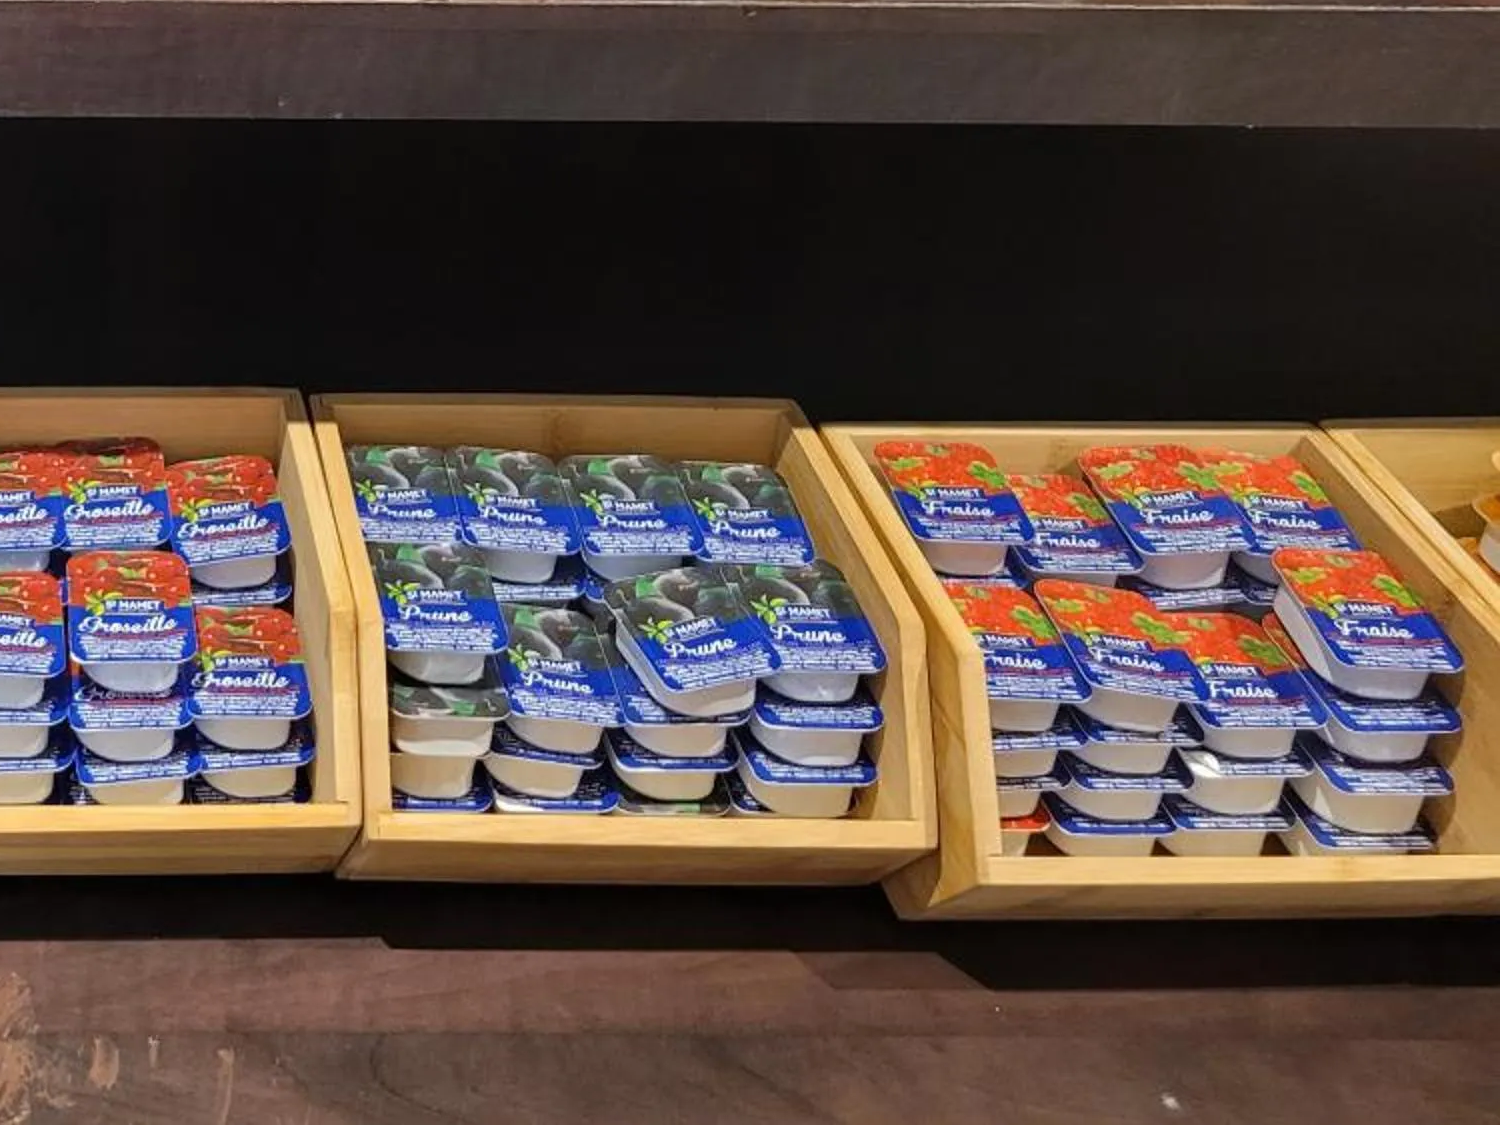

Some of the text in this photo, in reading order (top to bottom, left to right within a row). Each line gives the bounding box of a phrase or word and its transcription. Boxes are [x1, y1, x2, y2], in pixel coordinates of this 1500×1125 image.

[64, 499, 155, 519] Groseille
[368, 504, 437, 518] Prune
[479, 506, 547, 525] Prune
[921, 500, 995, 517] Fraise
[1140, 505, 1214, 524] Fraise
[178, 516, 270, 538] Groseille
[597, 514, 668, 529] Prune
[1248, 509, 1322, 529] Fraise
[709, 521, 781, 538] Prune
[1035, 532, 1101, 548] Fraise
[398, 605, 473, 622] Prune
[78, 615, 178, 634] Groseille
[770, 625, 846, 643] Prune
[1334, 619, 1414, 638] Fraise
[663, 638, 737, 658] Prune
[1088, 647, 1165, 671] Fraise
[192, 671, 290, 688] Groseille
[520, 672, 594, 694] Prune
[1207, 678, 1279, 699] Fraise
